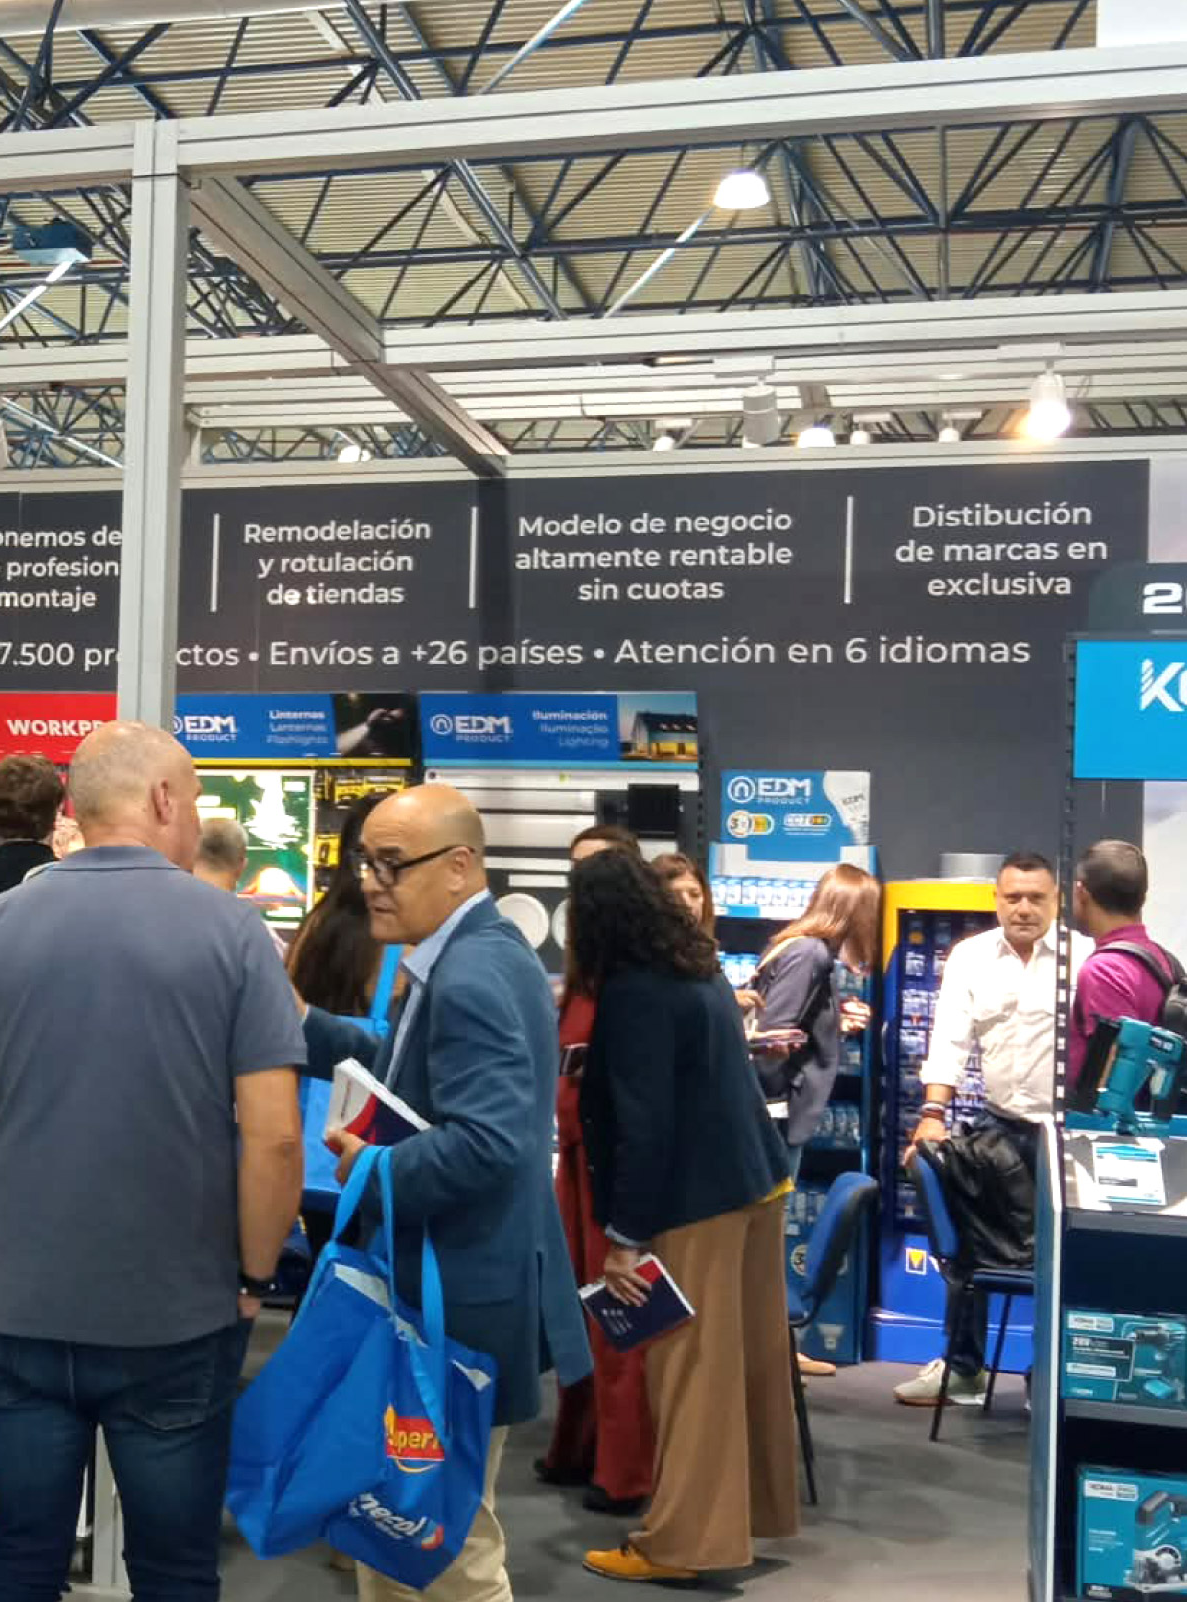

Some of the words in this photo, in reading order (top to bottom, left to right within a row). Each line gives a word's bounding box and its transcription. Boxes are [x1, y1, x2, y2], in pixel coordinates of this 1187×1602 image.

[519, 513, 622, 538] Modelo
[629, 512, 667, 535] de
[675, 509, 792, 538] negocio
[913, 500, 1092, 528] Distibución
[91, 525, 122, 547] de
[244, 518, 431, 544] Remodelación
[515, 546, 661, 570] altamente
[669, 542, 793, 567] rentable
[895, 539, 935, 563] de
[944, 542, 1059, 563] marcas
[1067, 541, 1107, 560] en
[6, 556, 120, 581] profesion
[258, 557, 275, 580] y
[281, 550, 413, 573] rotulación
[267, 583, 302, 606] de
[305, 582, 404, 606] tiendas
[578, 579, 619, 601] sin
[626, 579, 724, 601] cuotas
[927, 571, 1071, 596] exclusiva
[270, 640, 373, 666] Envíos
[381, 646, 400, 666] a
[411, 640, 468, 666] +26
[478, 638, 584, 671] países
[614, 636, 775, 664] Atención
[787, 643, 833, 664] en
[845, 637, 868, 664] 6
[879, 635, 1031, 664] idiomas
[184, 715, 237, 733] EDM
[456, 716, 511, 733] EDM
[758, 778, 811, 796] EDM
